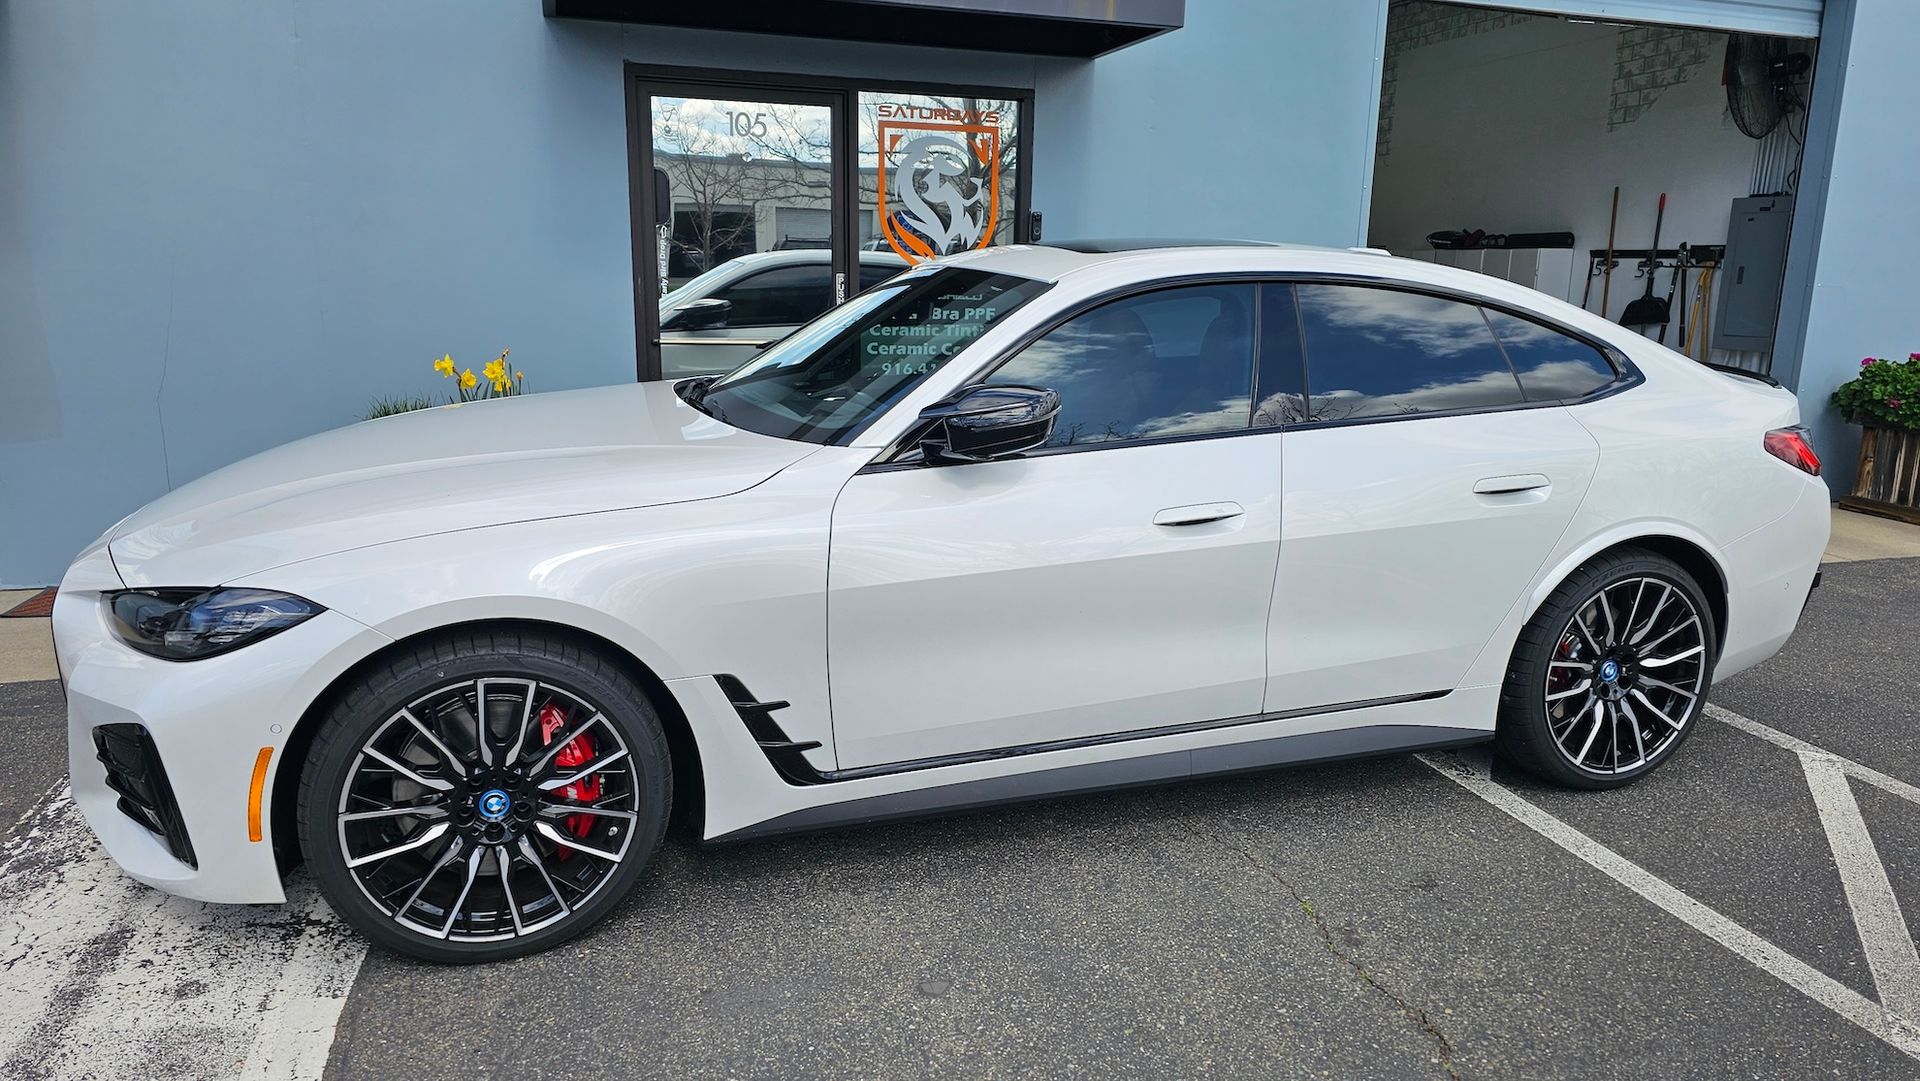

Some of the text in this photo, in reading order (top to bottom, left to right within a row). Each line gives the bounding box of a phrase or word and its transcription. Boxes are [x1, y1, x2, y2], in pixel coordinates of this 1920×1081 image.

[878, 104, 1000, 124] SATURDAYS
[725, 111, 768, 138] 105
[659, 239, 667, 259] Drop
[659, 260, 667, 277] Bird
[932, 307, 960, 321] Bra
[964, 307, 996, 321] PPF
[869, 322, 940, 337] Ceramic
[866, 341, 937, 356] Ceramic
